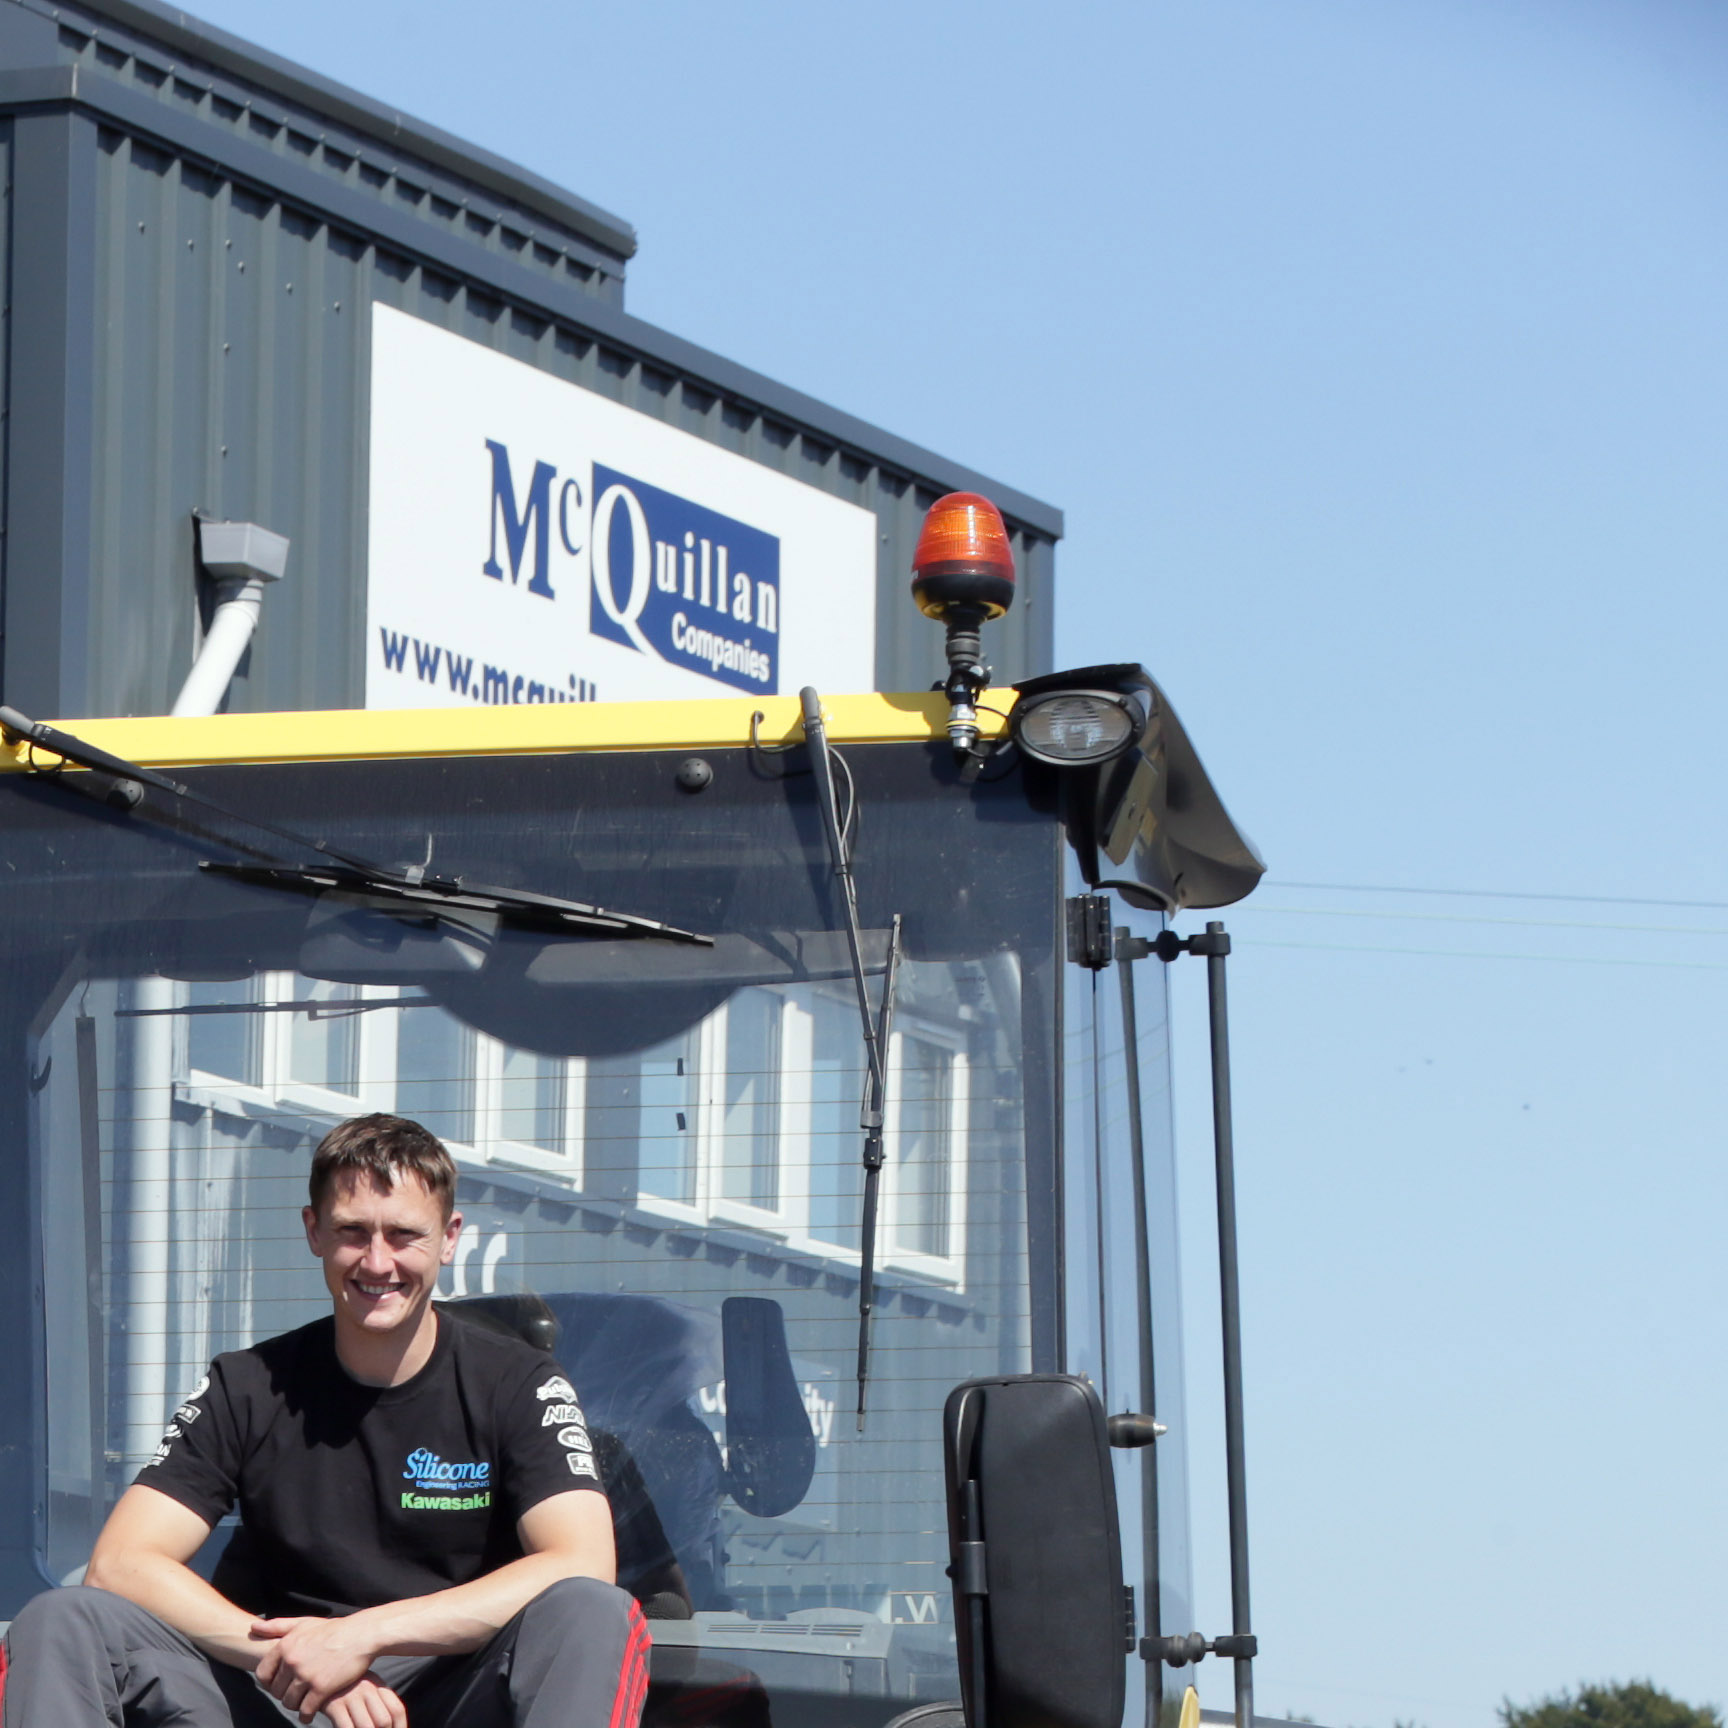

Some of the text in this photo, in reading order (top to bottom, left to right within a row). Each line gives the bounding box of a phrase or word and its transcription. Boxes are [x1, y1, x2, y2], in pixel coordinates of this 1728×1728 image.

[671, 611, 770, 684] Companies
[402, 1447, 490, 1480] Silicone
[401, 1491, 491, 1511] Kawasaki
